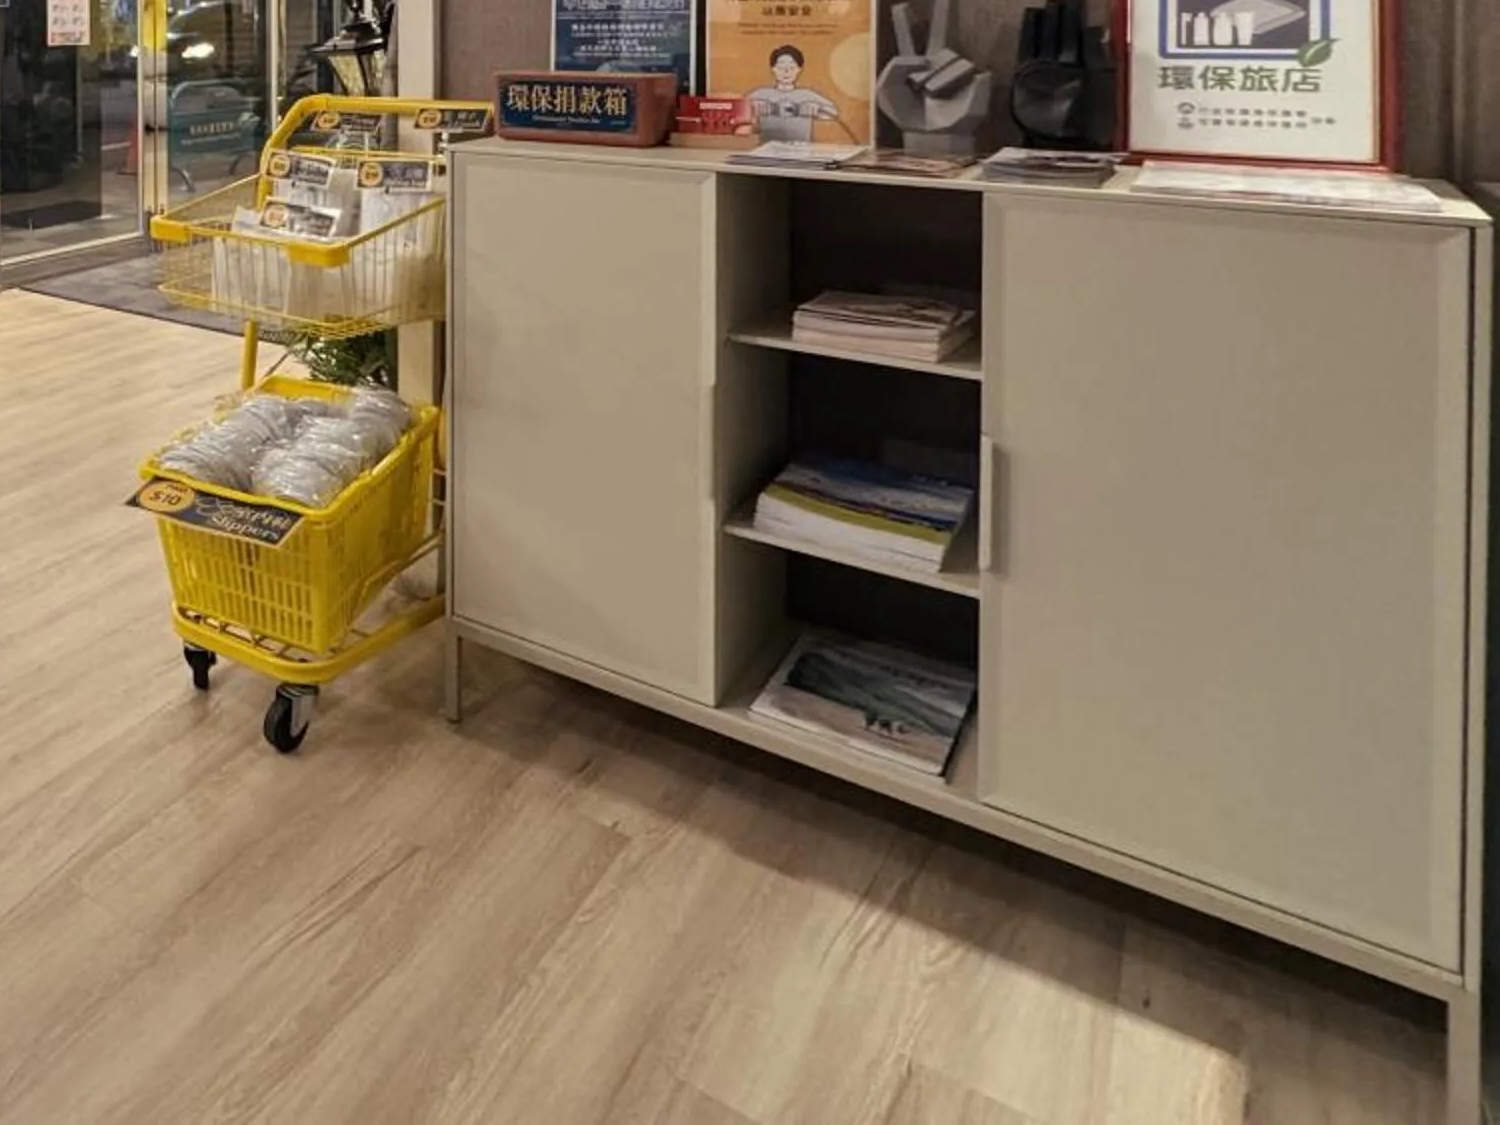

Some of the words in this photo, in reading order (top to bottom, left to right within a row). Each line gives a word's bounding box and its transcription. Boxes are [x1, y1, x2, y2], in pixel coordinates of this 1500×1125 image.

[1158, 64, 1323, 93] 環保旅店
[506, 83, 627, 116] 環保捐款箱
